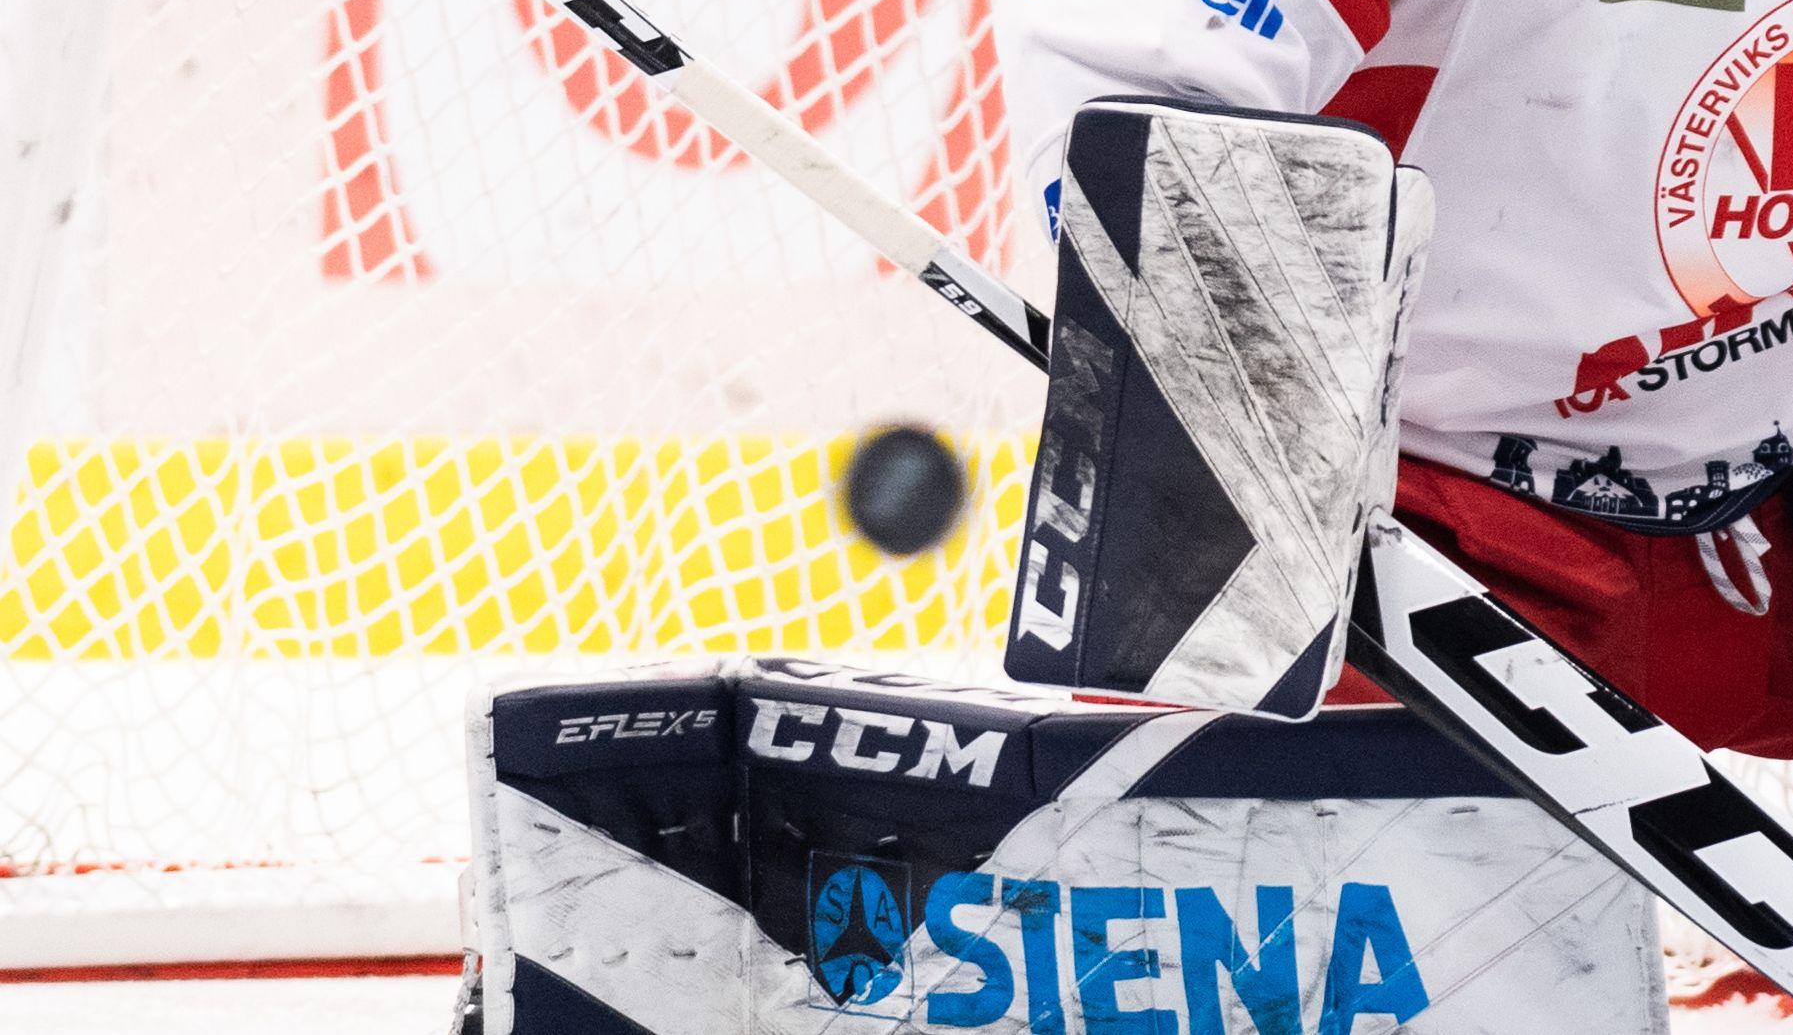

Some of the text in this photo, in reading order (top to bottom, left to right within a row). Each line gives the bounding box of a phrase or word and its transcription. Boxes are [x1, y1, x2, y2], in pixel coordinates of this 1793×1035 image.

[1660, 23, 1790, 229] VÄSTERVIKS
[936, 281, 984, 316] 5.9
[746, 697, 1009, 788] CCM
